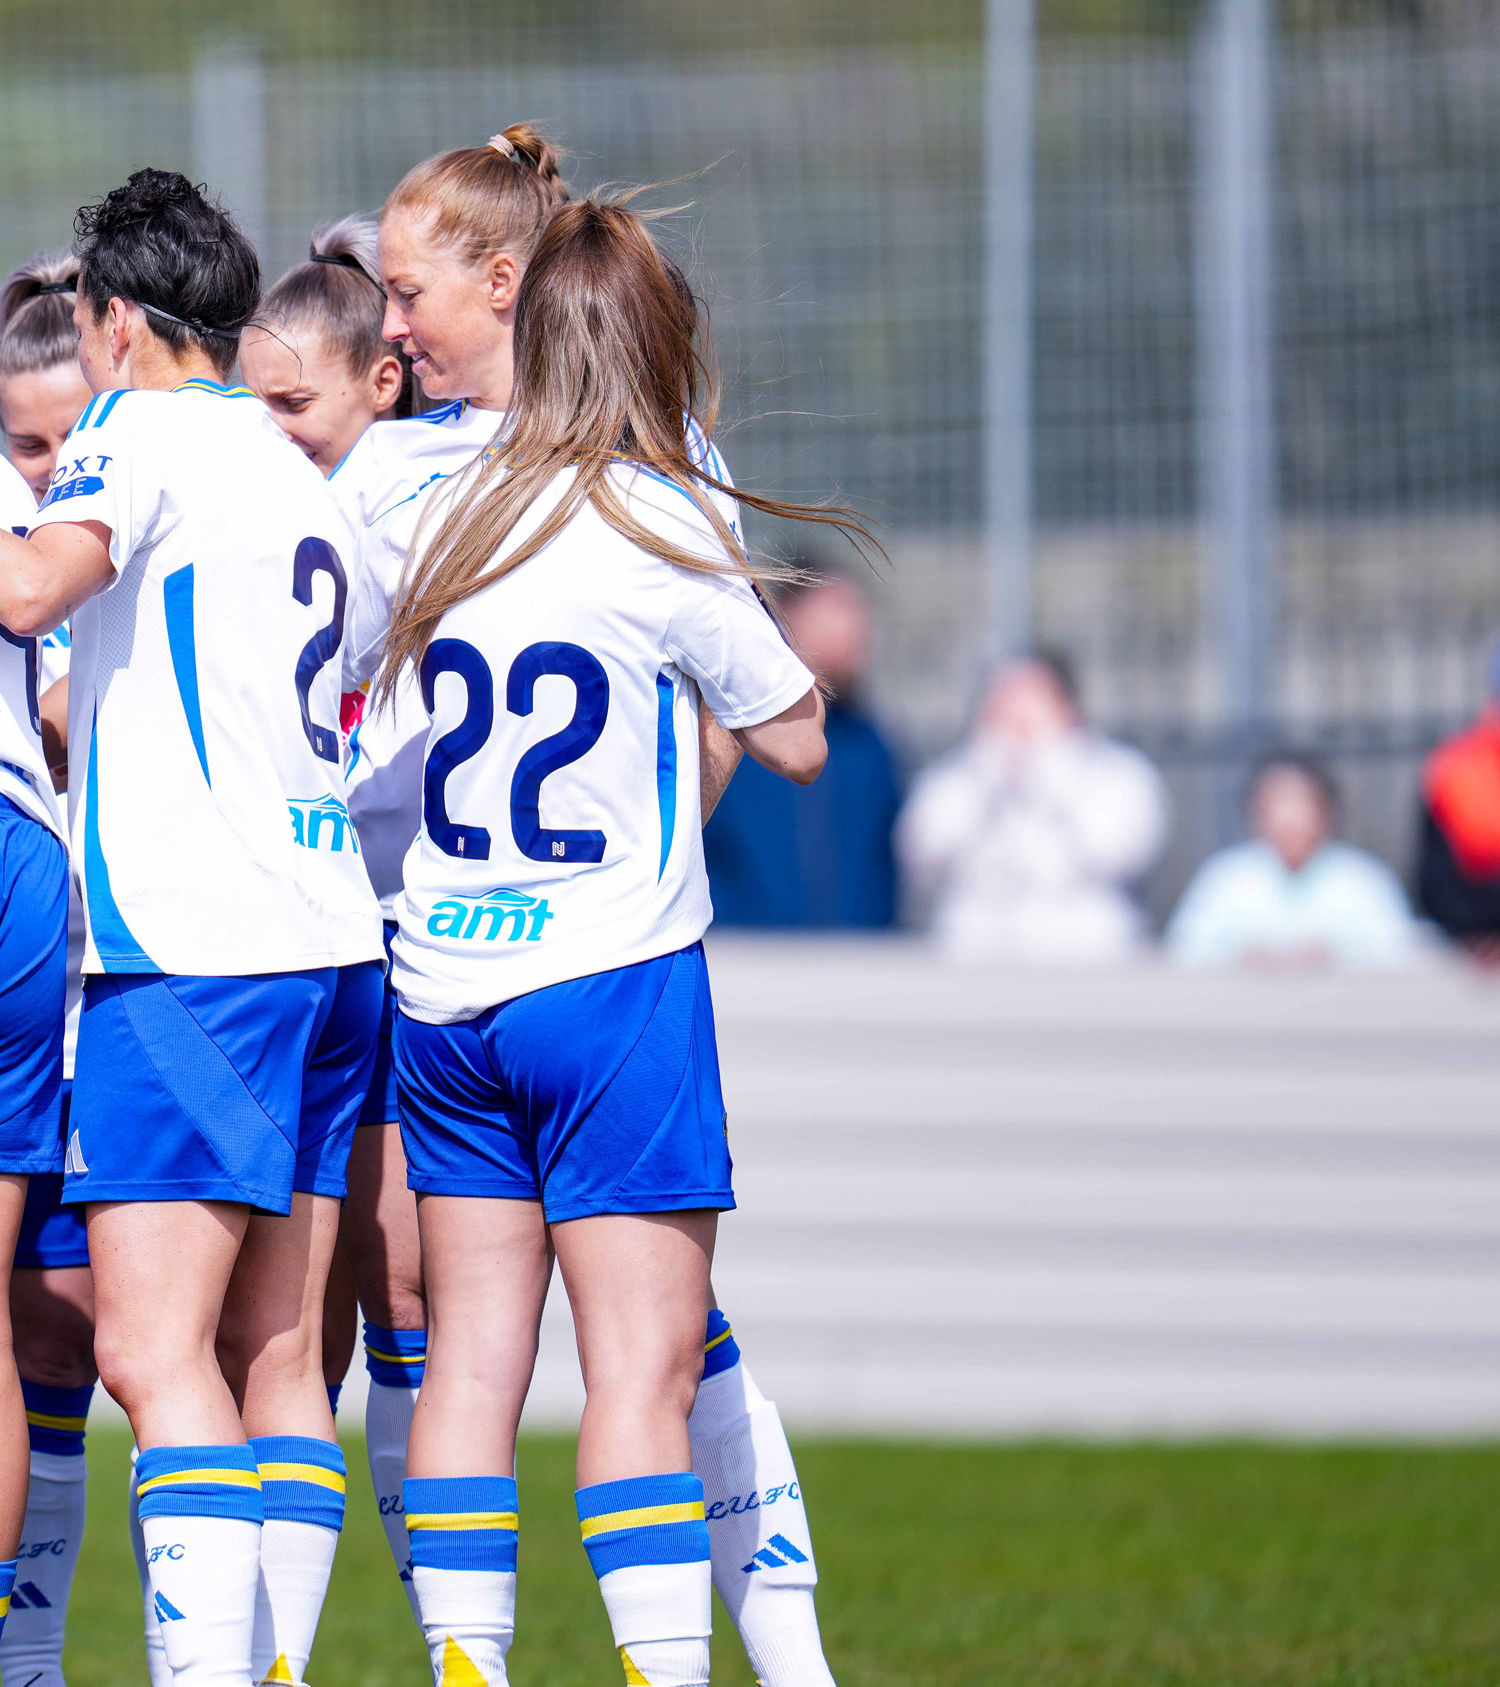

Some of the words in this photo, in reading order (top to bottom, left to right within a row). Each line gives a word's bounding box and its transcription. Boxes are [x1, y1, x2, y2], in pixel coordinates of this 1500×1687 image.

[47, 477, 87, 505] IFE
[51, 455, 113, 486] OXT
[292, 536, 348, 764] 2
[420, 637, 610, 863] 22
[287, 805, 359, 854] am
[426, 898, 555, 942] amt
